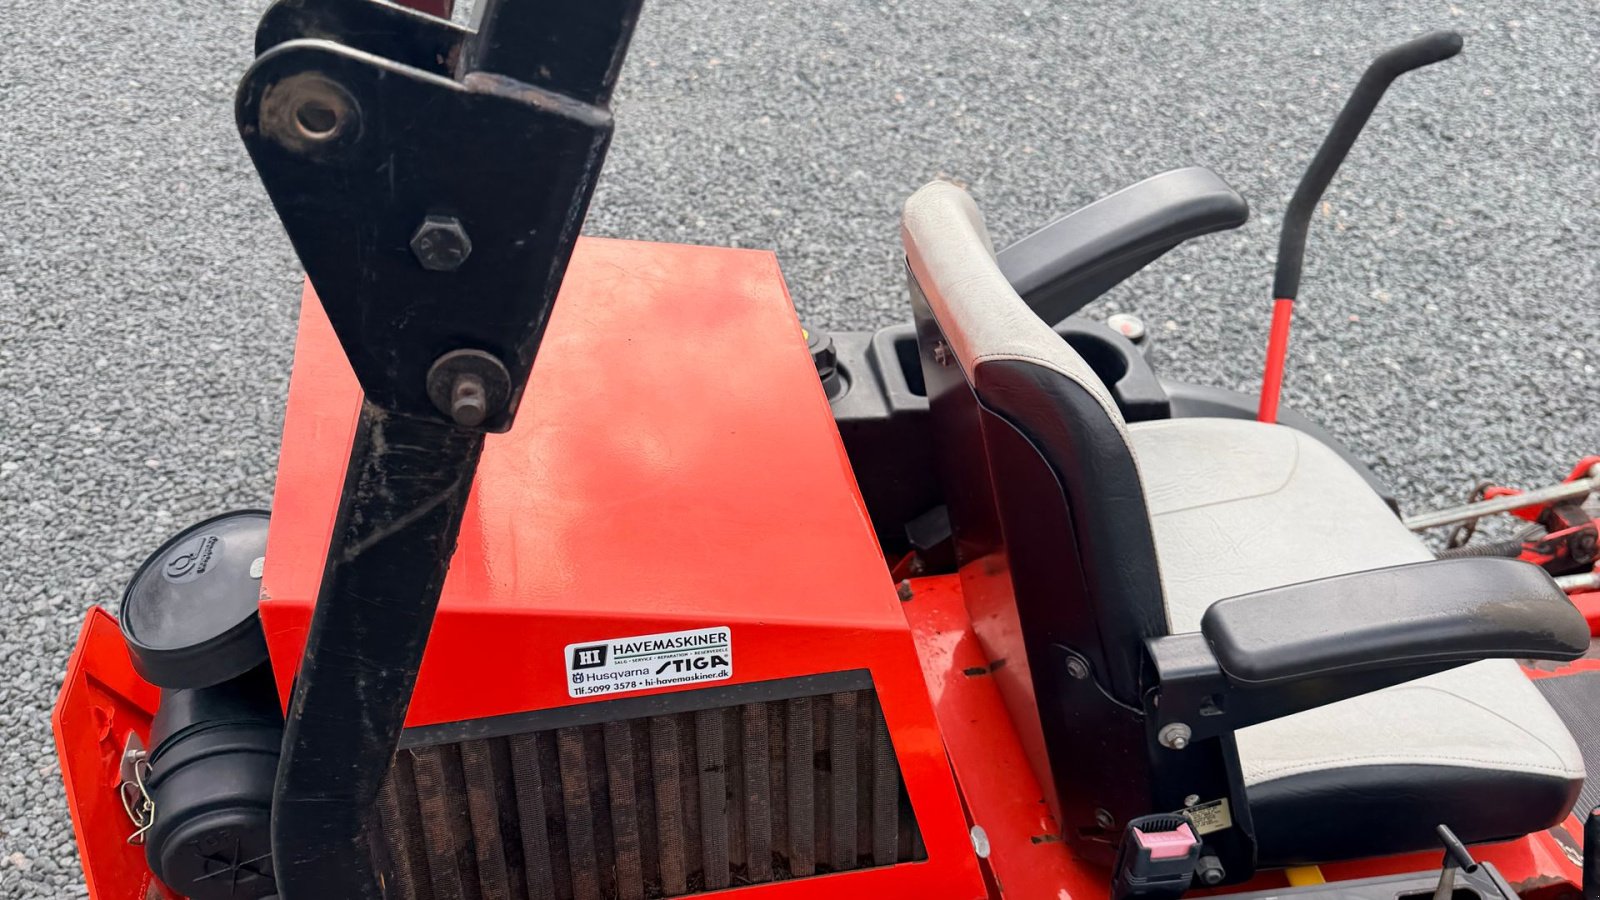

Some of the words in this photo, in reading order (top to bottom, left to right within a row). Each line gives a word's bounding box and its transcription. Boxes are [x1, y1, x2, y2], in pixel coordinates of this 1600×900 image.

[578, 649, 601, 666] HI
[613, 632, 728, 655] HAVEMASKINER
[657, 652, 689, 660] REPARATION
[586, 667, 650, 682] Husqvarna
[656, 654, 729, 675] STIGA
[613, 681, 637, 690] 3578
[645, 669, 729, 687] hi-havemaskiner.dk
